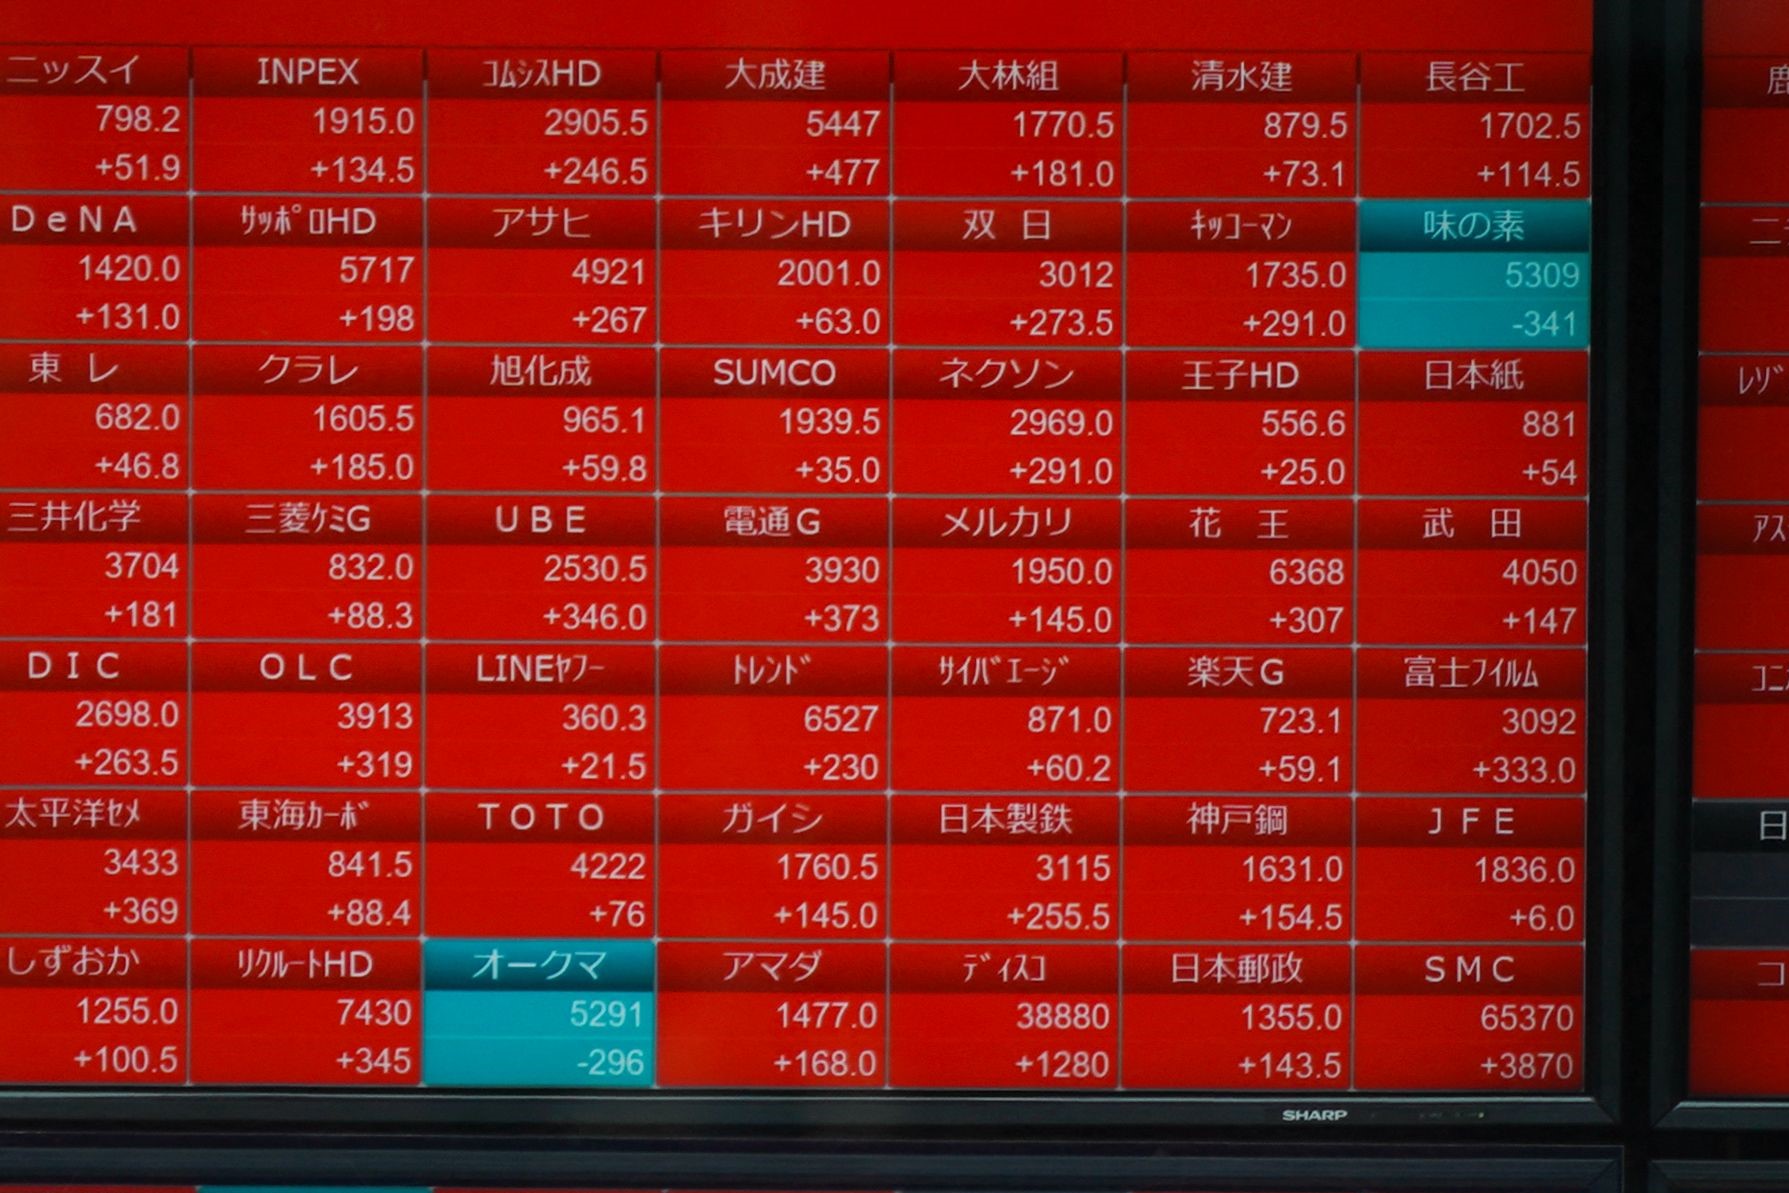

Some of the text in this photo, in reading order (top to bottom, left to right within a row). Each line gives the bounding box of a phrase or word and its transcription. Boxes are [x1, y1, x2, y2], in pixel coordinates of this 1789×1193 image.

[257, 57, 359, 86] INPEX
[1192, 59, 1293, 92] 清水建
[314, 106, 415, 135] 1915.0
[1263, 111, 1348, 139] 879.5
[311, 155, 415, 184] +134.5
[1263, 159, 1343, 188] +73.1
[494, 206, 590, 238] アサヒ
[1424, 209, 1524, 243] 味の素
[571, 257, 644, 286] 4921
[1505, 260, 1581, 289] 5309
[572, 305, 648, 334] +267
[1512, 310, 1575, 337] -341
[259, 353, 359, 385] クラレ
[714, 357, 837, 387] SUMCO
[314, 404, 415, 432] 1605.5
[780, 407, 881, 435] 1939.5
[310, 452, 415, 481] +185.0
[795, 455, 881, 484] +35.0
[9, 499, 141, 532] 三井化学
[942, 505, 1071, 538] メルカリ
[105, 551, 180, 580] 3704
[1012, 556, 1114, 585] 1950.0
[104, 600, 176, 628] +181
[1008, 605, 1113, 634] +145.0
[1260, 706, 1340, 734] 723.1
[1259, 754, 1340, 783] +59.1
[940, 802, 1072, 834] 日本製鉄
[1036, 853, 1111, 882] 3115
[1007, 902, 1111, 931] +255.5
[473, 948, 607, 980] オークマ
[1172, 951, 1303, 984] 日本郵政
[570, 999, 641, 1028] 5291
[1242, 1002, 1343, 1031] 1355.0
[577, 1048, 645, 1076] -296
[1238, 1051, 1342, 1079] +143.5
[1282, 1109, 1348, 1121] SHARP
